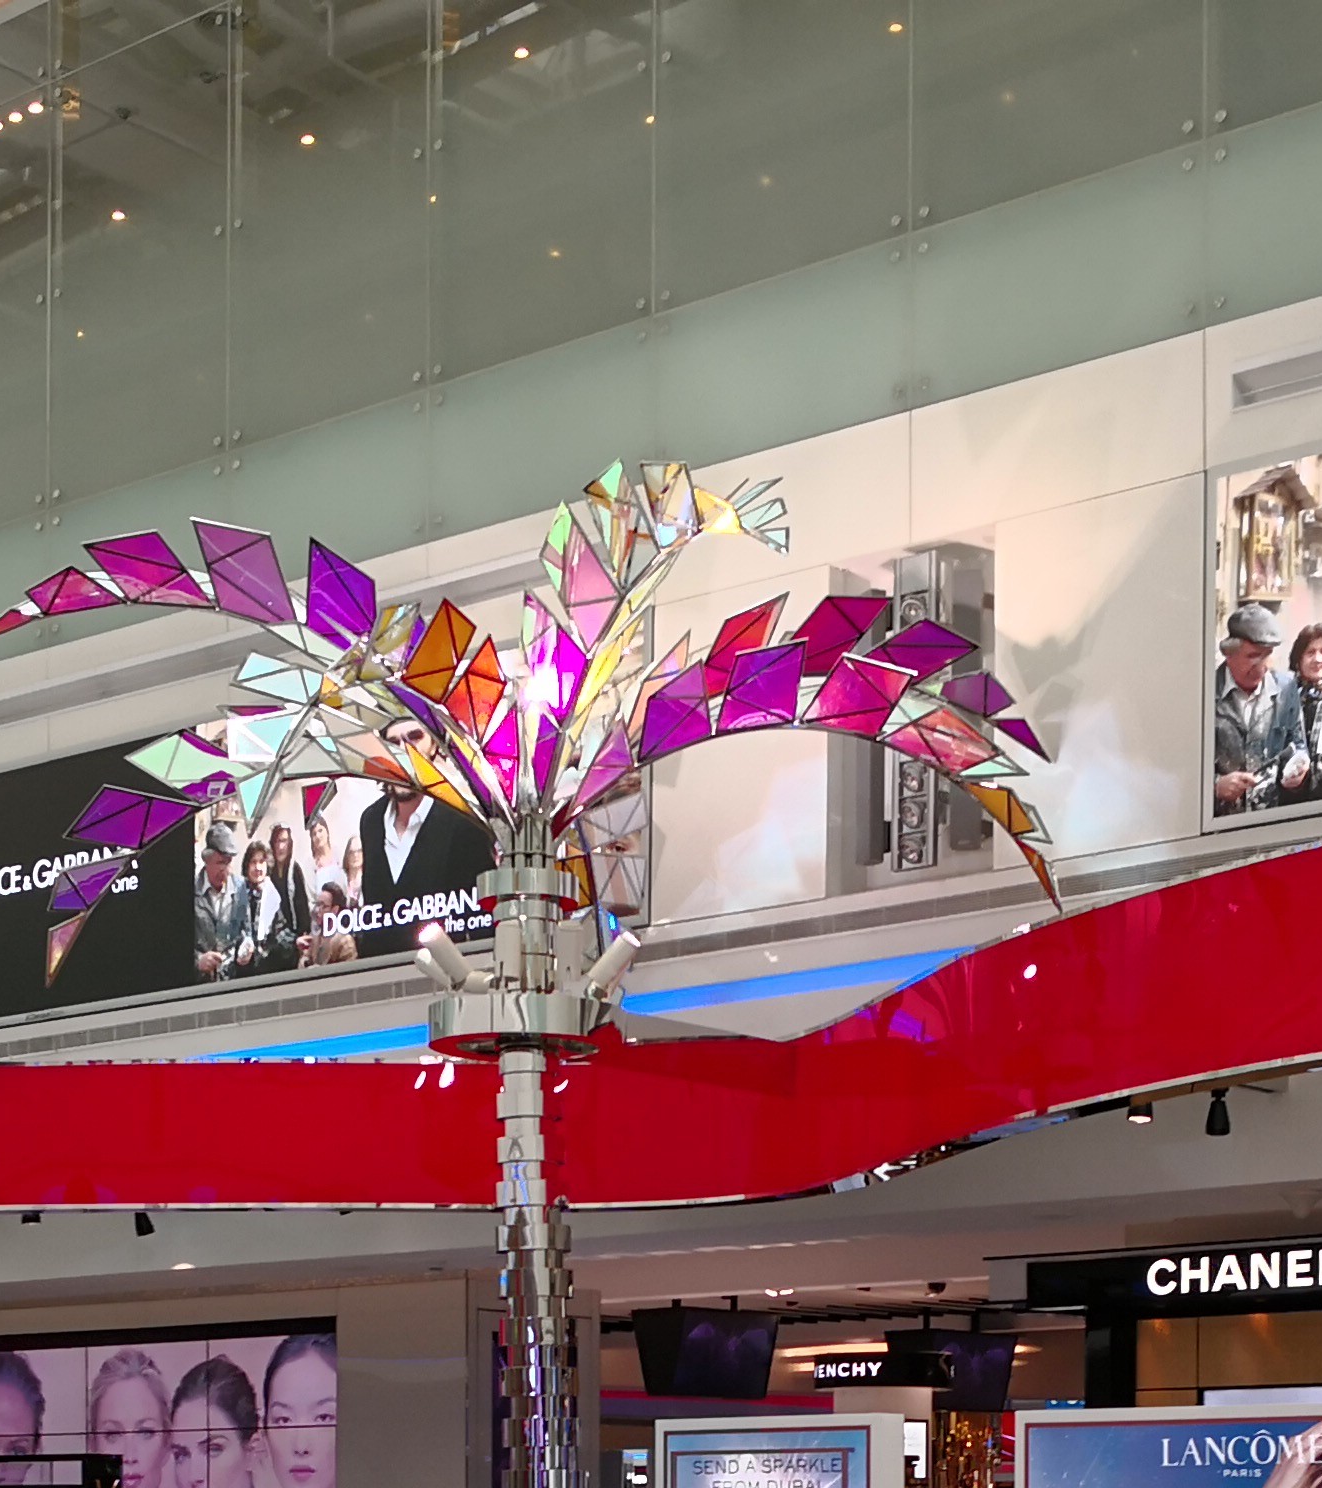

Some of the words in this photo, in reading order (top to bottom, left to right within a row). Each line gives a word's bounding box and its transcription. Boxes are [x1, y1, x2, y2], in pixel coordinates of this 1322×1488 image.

[322, 903, 383, 937] DOLCE
[392, 886, 481, 924] GABBAN
[444, 917, 464, 933] the
[467, 913, 492, 929] one
[692, 1459, 740, 1475] SEND
[746, 1458, 756, 1473] A
[761, 1457, 842, 1474] SPARKLE
[1222, 1468, 1263, 1478] PARIS
